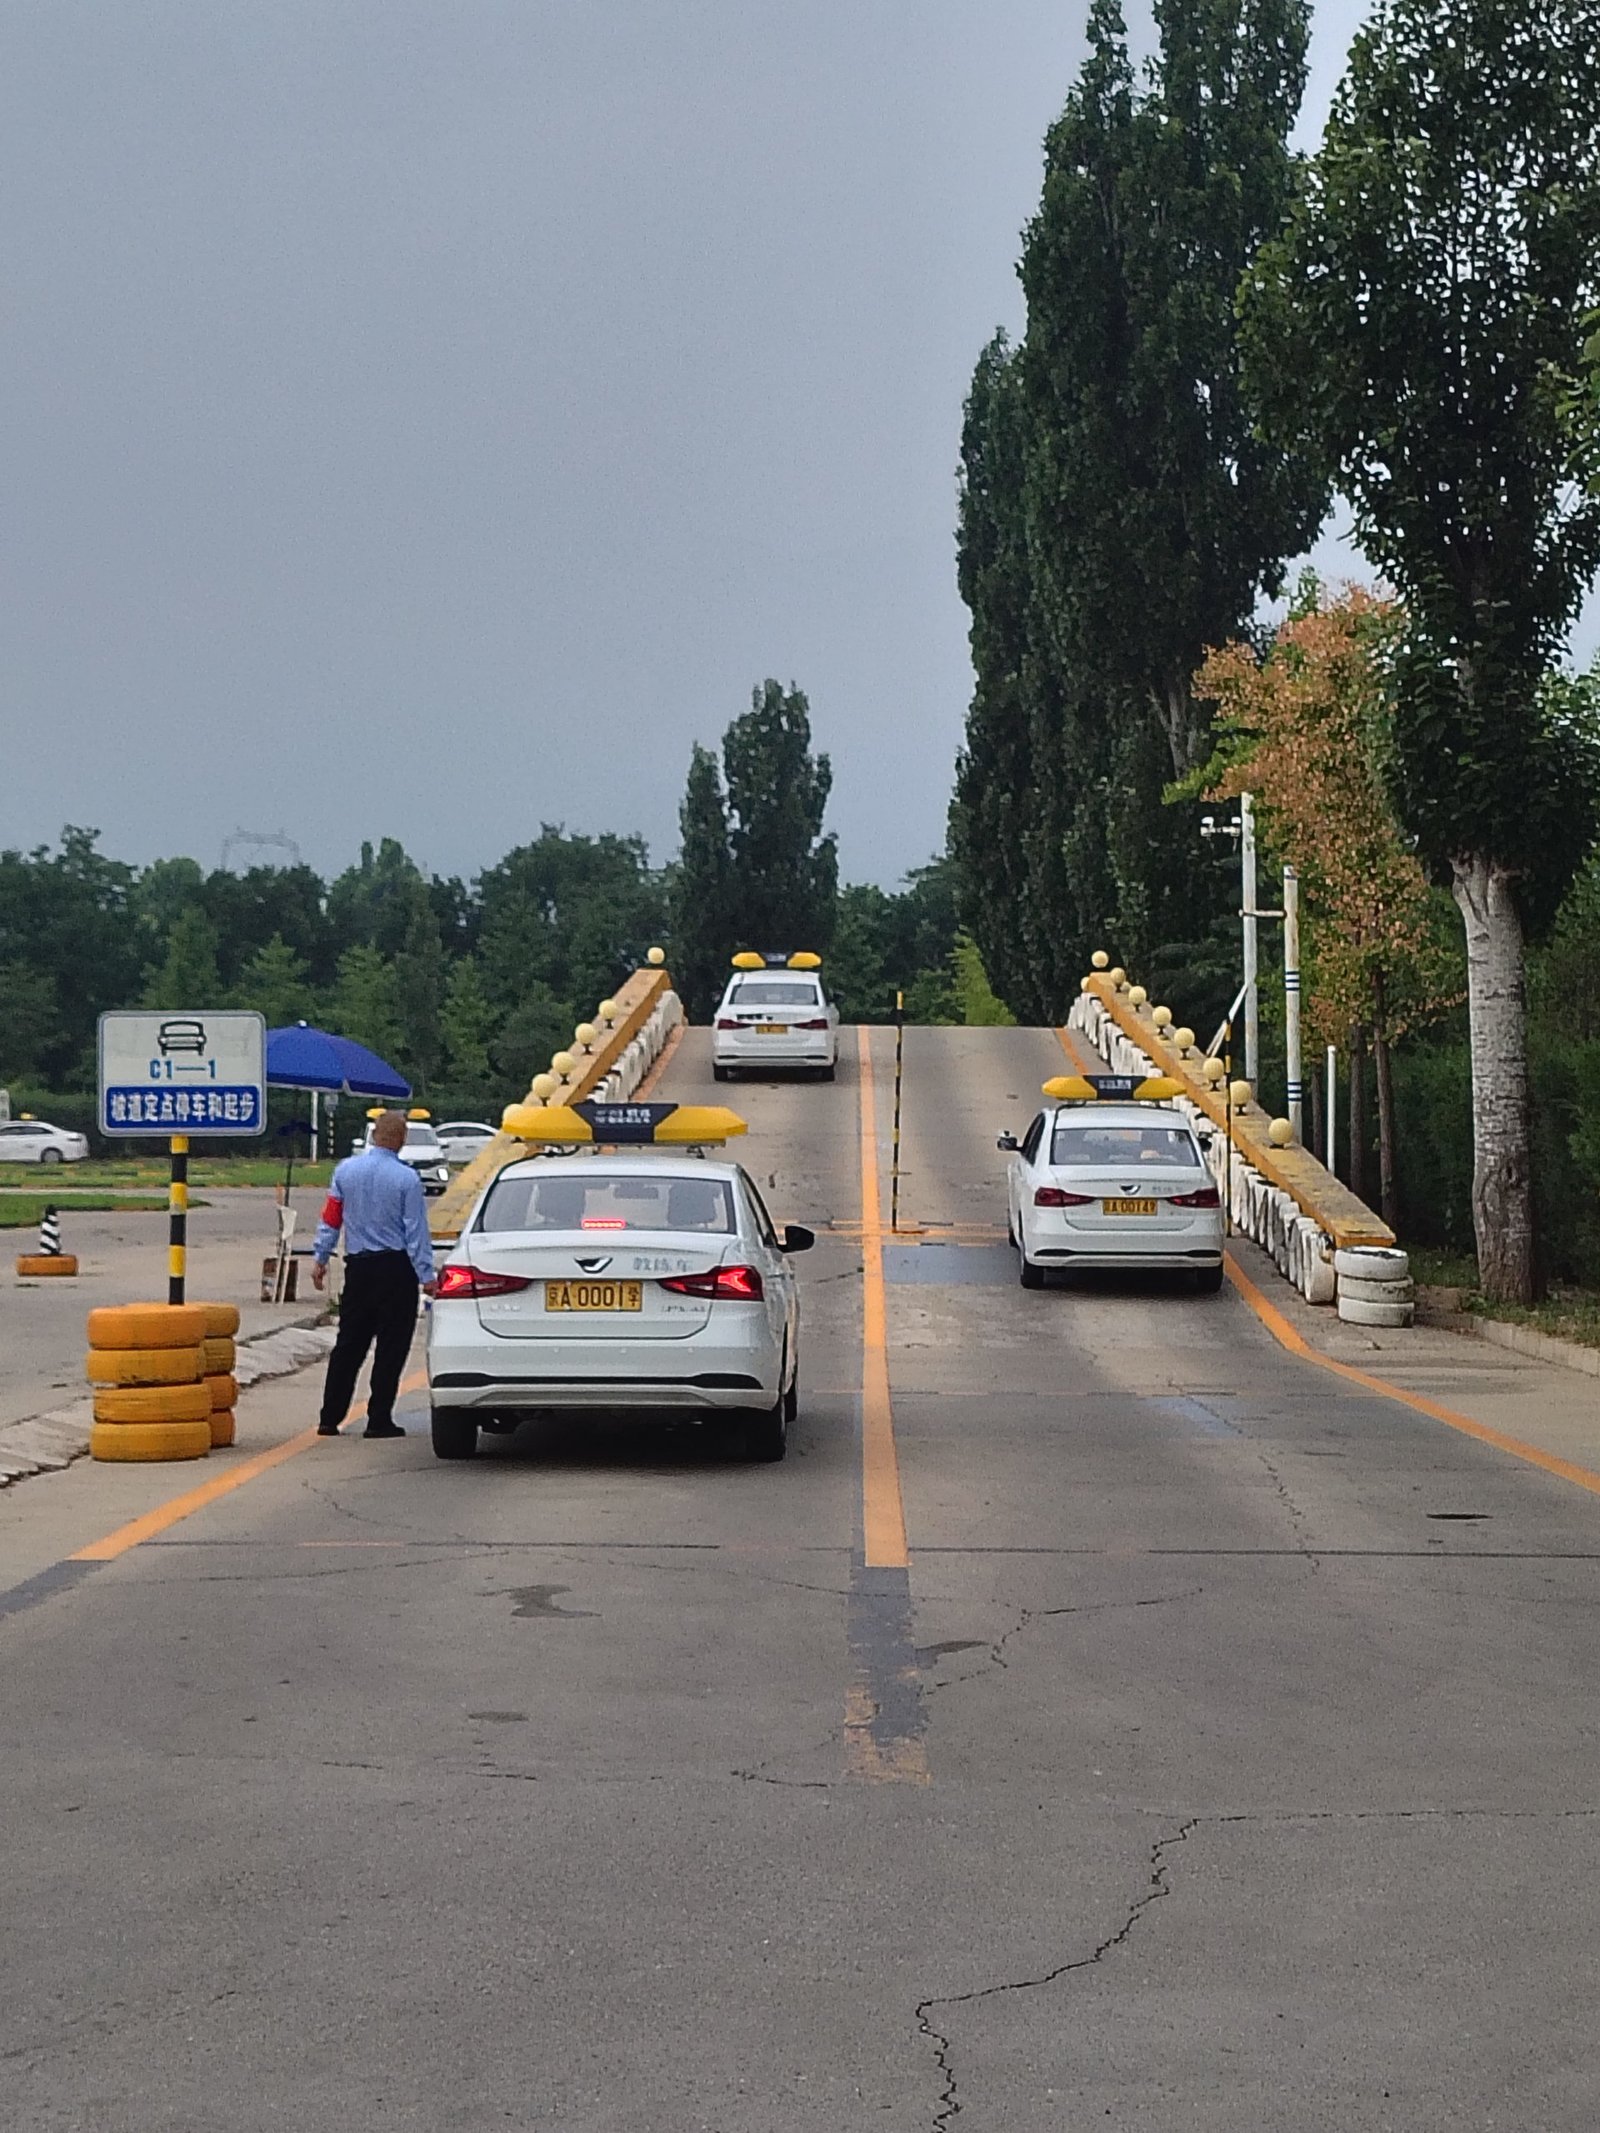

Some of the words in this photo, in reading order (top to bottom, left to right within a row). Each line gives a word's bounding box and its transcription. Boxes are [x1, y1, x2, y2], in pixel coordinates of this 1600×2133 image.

[111, 1091, 255, 1122] 坡道定点停车和起步
